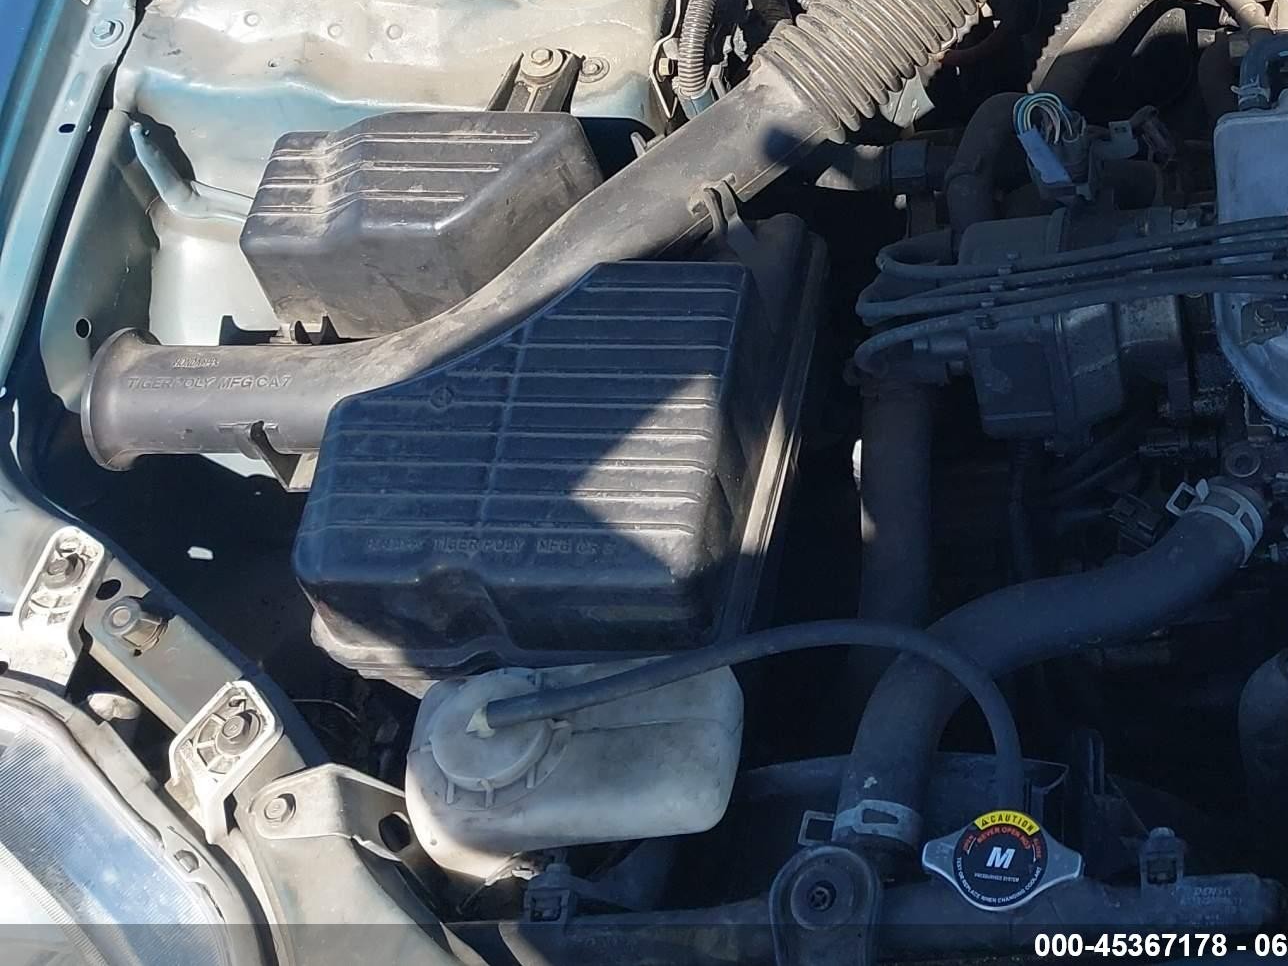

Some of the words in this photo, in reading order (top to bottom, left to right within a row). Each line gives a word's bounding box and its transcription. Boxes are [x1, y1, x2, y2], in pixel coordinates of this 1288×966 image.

[990, 814, 1035, 834] CAUTION
[986, 846, 1016, 869] M
[962, 879, 981, 900] REPLACE
